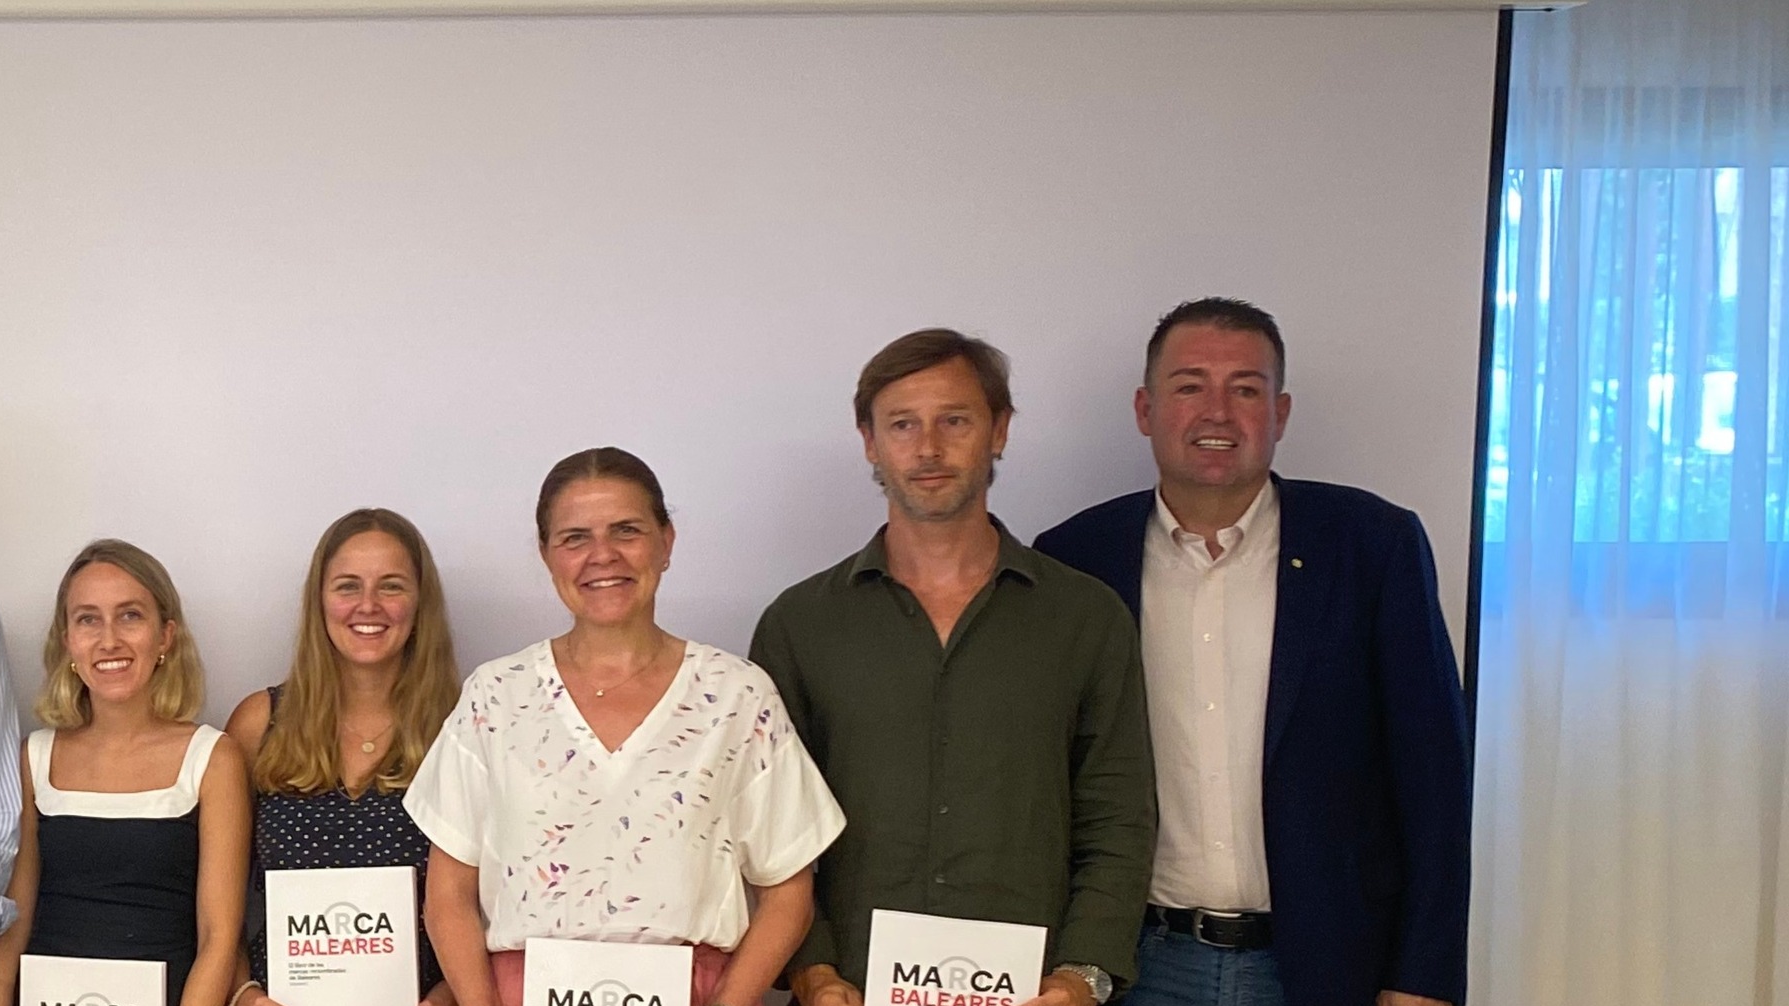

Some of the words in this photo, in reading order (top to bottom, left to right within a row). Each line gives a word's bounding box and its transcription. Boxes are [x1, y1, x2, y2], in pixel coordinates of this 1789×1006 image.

[288, 912, 394, 936] MARCA
[288, 937, 394, 956] BALEARES
[892, 962, 1015, 994] MARCA
